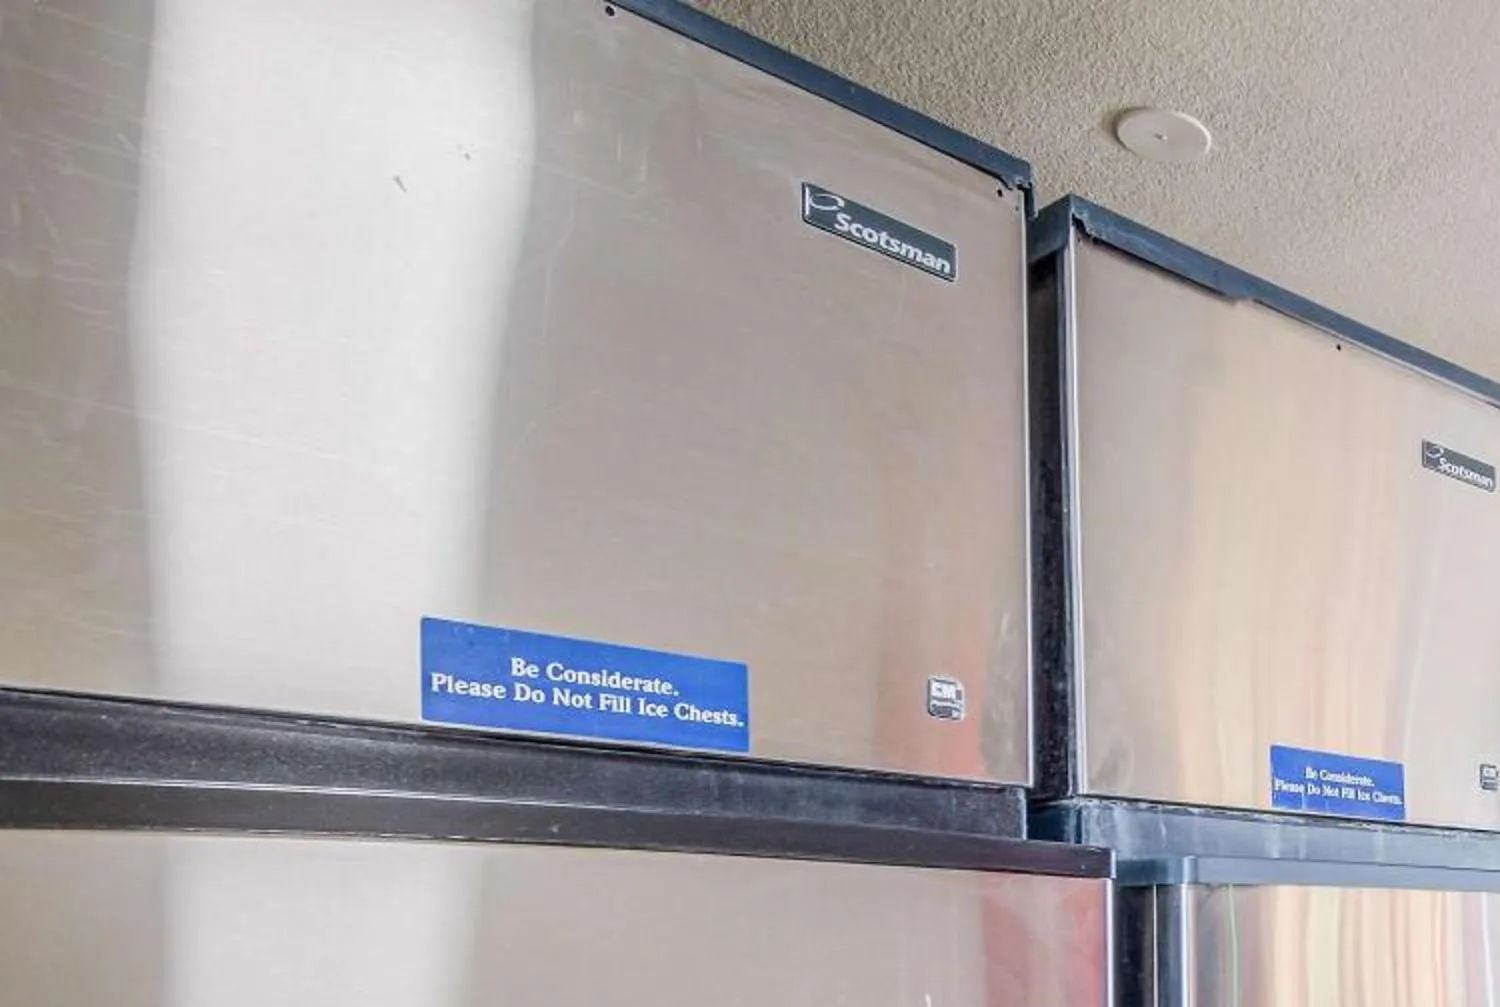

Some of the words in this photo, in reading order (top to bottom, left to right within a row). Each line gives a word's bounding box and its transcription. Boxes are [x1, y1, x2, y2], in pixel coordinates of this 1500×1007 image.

[833, 212, 951, 274] Scotsman
[1439, 457, 1493, 488] Scotsman
[511, 656, 540, 679] Be
[546, 662, 680, 697] Considerate.
[431, 672, 506, 699] Please
[514, 682, 545, 703] Do
[552, 687, 593, 709] Not
[599, 692, 631, 713] Fill
[638, 698, 669, 718] Ice
[673, 702, 745, 728] Chests.
[1274, 778, 1305, 793] Please
[1307, 782, 1321, 795] Do
[1322, 784, 1339, 797] Not
[1341, 787, 1355, 799] Fill
[1357, 788, 1370, 801] Ice
[1305, 767, 1318, 780] Be
[1319, 769, 1375, 787] Considerate.
